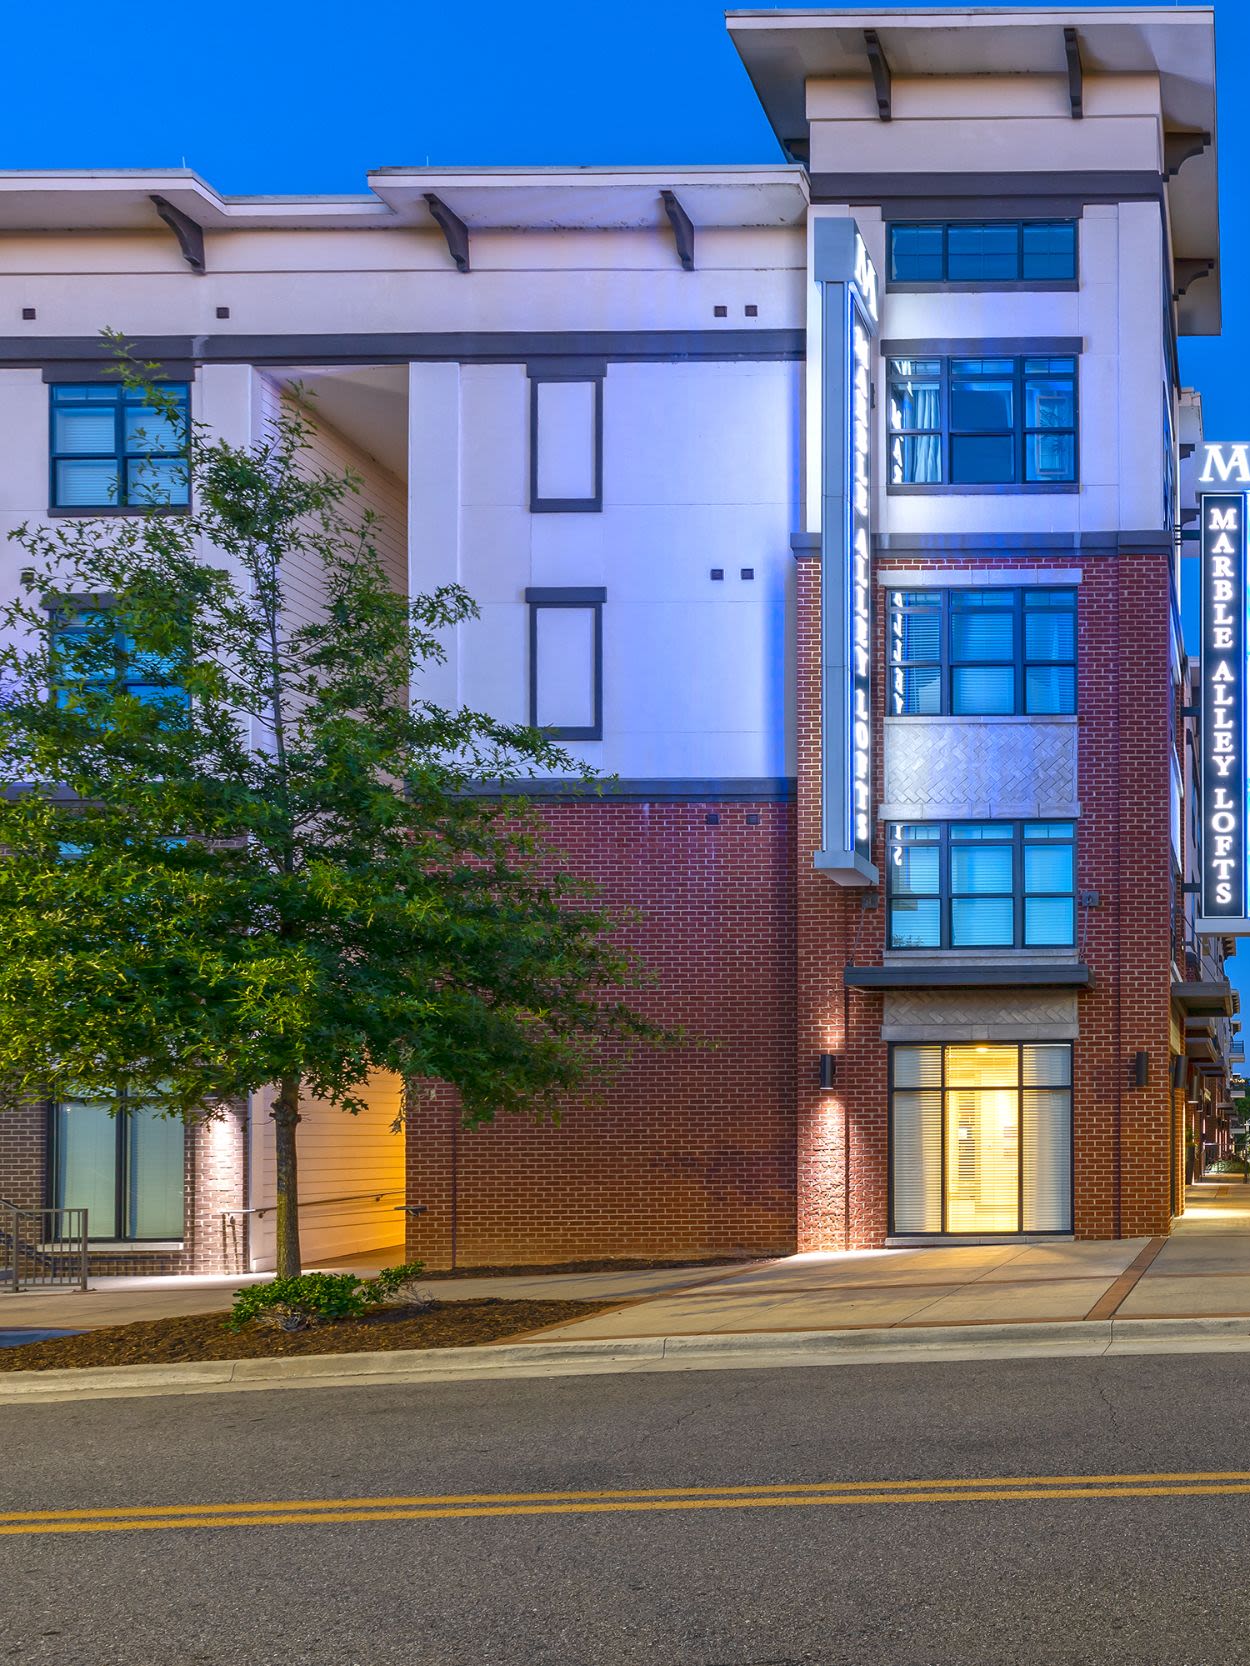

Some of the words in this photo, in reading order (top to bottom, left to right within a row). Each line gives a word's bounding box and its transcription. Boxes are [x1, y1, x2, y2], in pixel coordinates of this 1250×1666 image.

[1209, 507, 1238, 649] MARBLE
[854, 688, 869, 841] LOFTS
[1212, 660, 1235, 777] ALLEY
[1211, 788, 1236, 904] LOFTS
